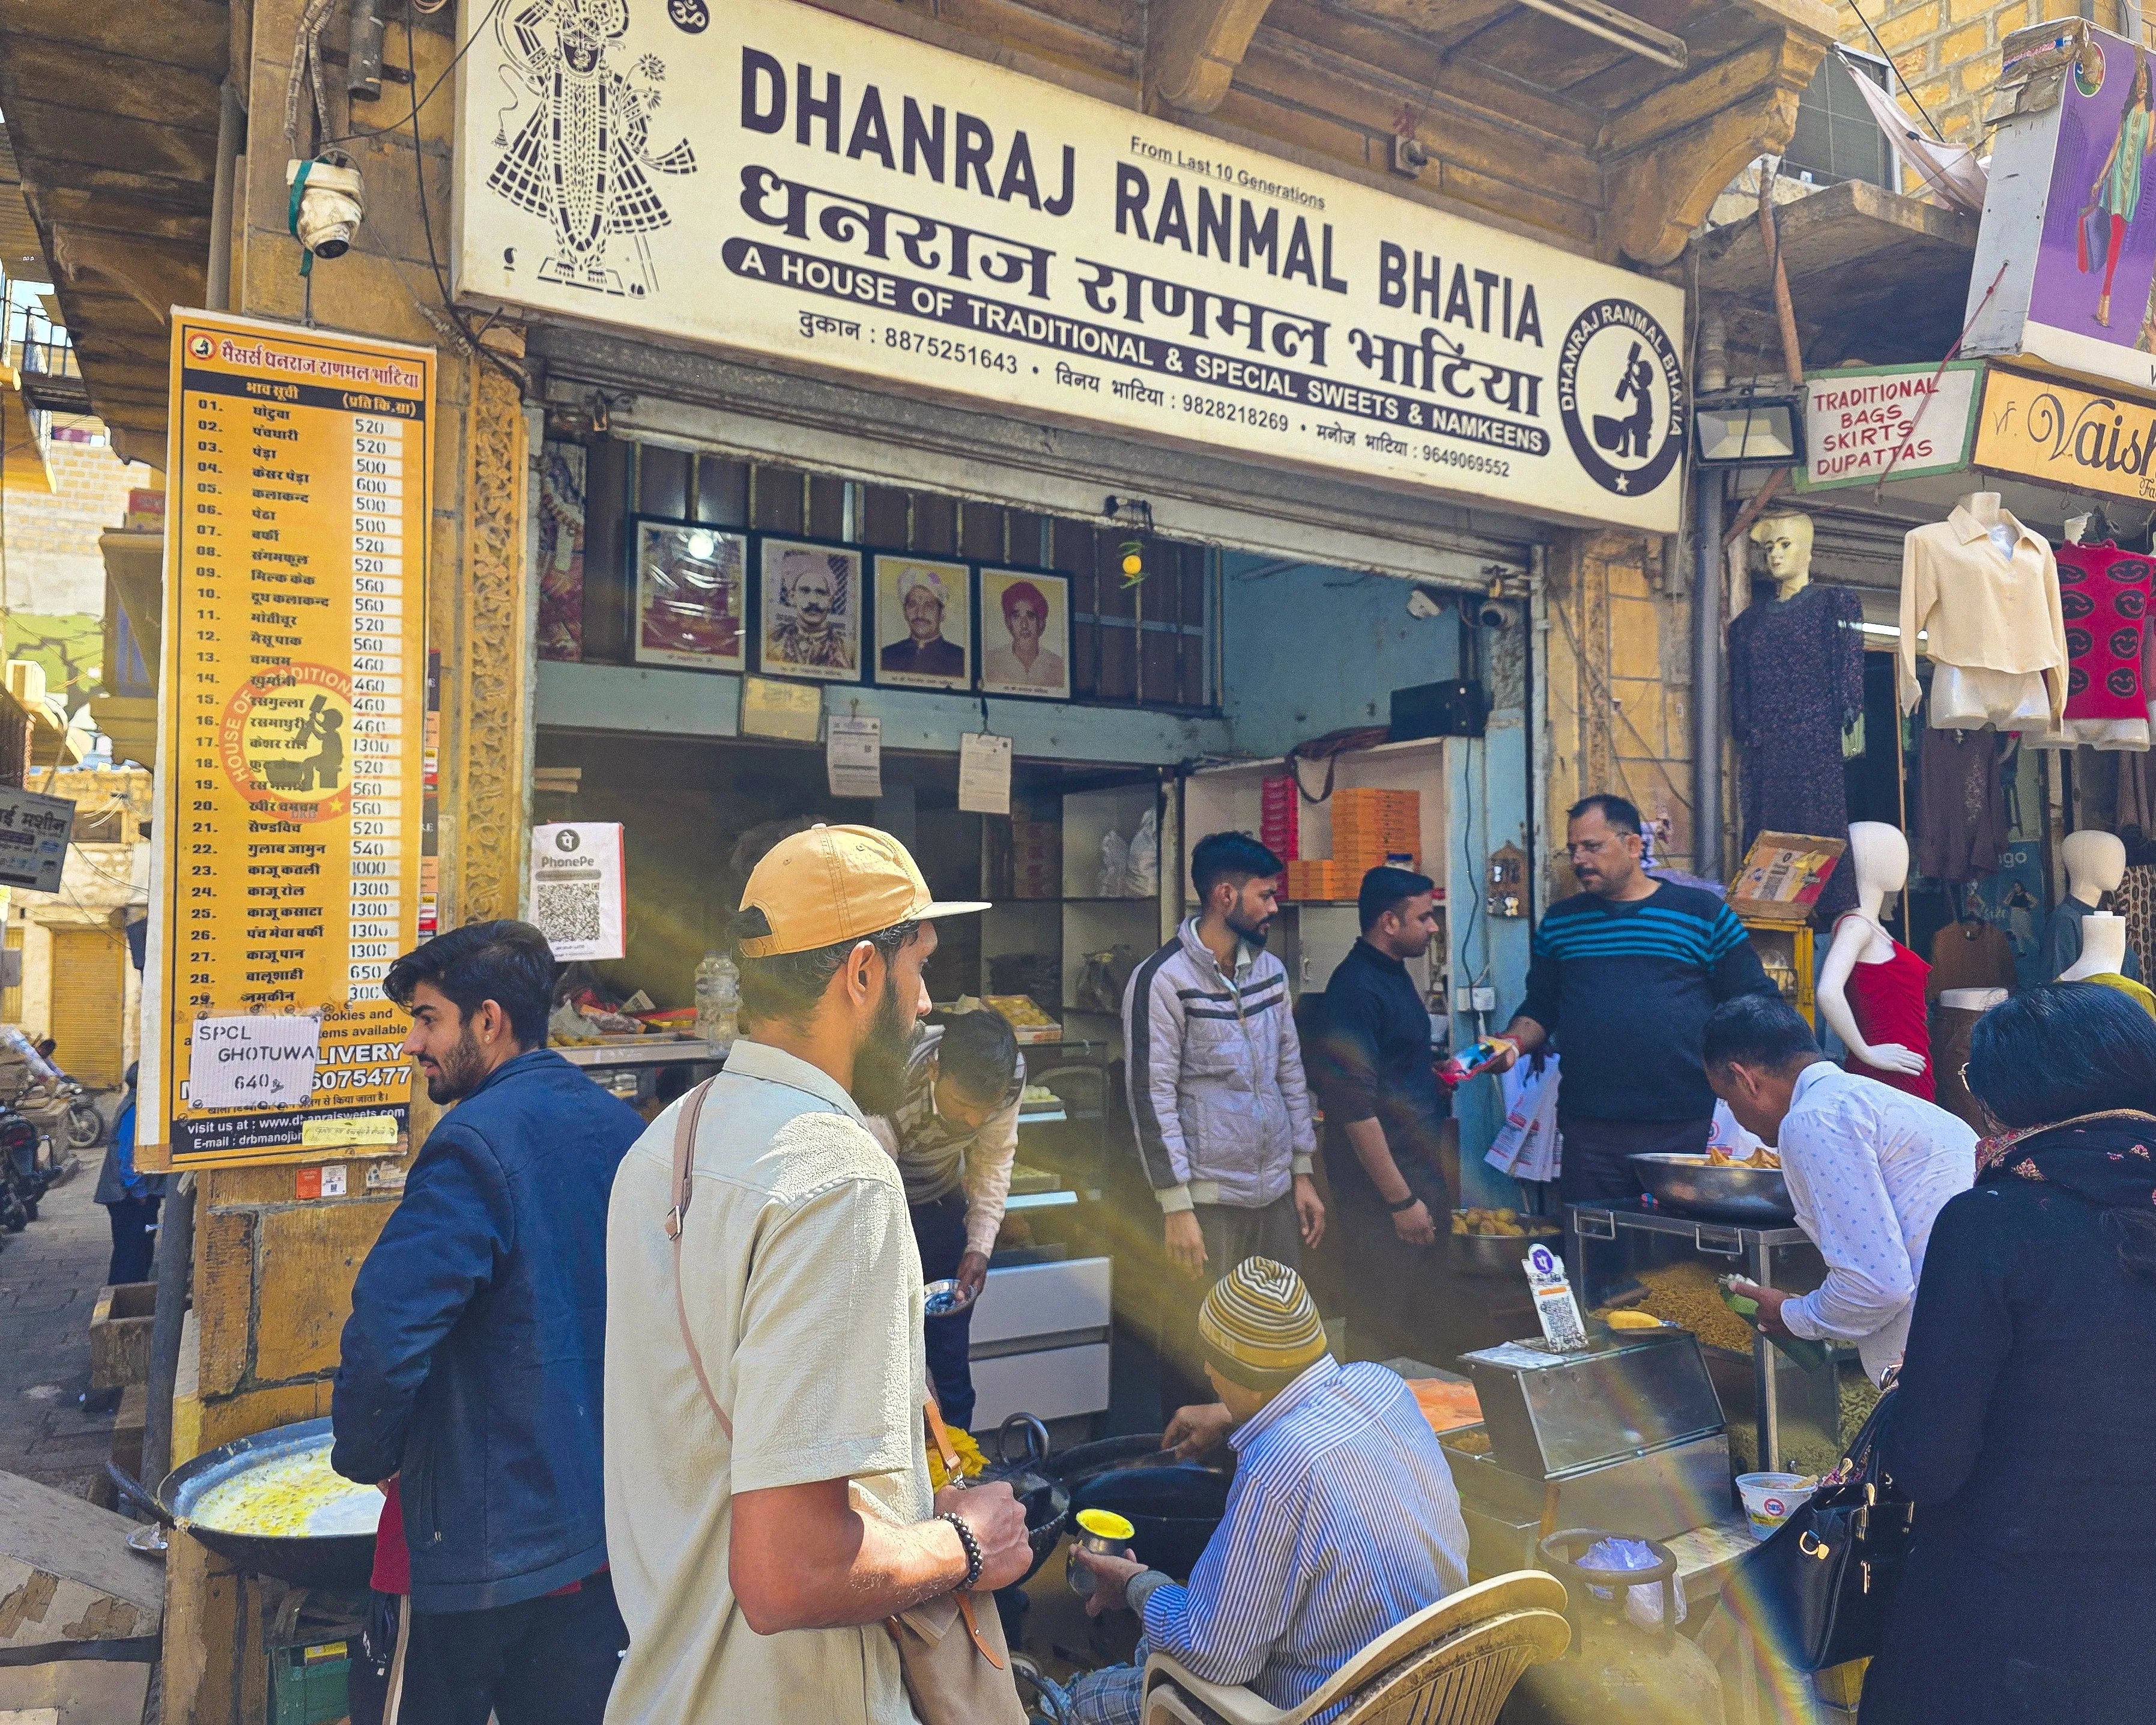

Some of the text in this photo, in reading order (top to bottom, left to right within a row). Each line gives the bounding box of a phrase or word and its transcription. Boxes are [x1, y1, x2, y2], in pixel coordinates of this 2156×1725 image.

[1131, 136, 1326, 208] From Last 10 Generations
[741, 46, 1544, 347] DHANRAJ RANMAL BHATIA
[740, 164, 1545, 417] धनराज राणमल भाटिया
[740, 247, 1542, 452] A HOUSE OF TRADITIONAL & SPECIAL SWEETS & NAMKEENS
[222, 341, 419, 388] मैसर्स धनराज राणमल भाटिया
[1561, 305, 1682, 435] DHANRAJ RANMAL BHATIA
[799, 310, 1510, 477] दुकान 8875251643 विनय भाटिया 9828218269 मनोज भाटिया 9649069552
[1814, 378, 1939, 411] TRADITIONAL
[1841, 405, 1903, 429] BAGS
[356, 419, 384, 434] 520
[1823, 421, 1914, 452] SKIRTS
[357, 438, 386, 455] 520
[1817, 440, 1933, 476] DUPATTAS
[357, 458, 386, 474] 500
[357, 477, 386, 494] 600
[357, 497, 386, 512] 500
[356, 518, 385, 533] 500
[356, 538, 384, 553] 520
[355, 558, 383, 573] 520
[356, 578, 384, 593] 560
[356, 598, 384, 612] 560
[356, 617, 384, 632] 520
[354, 637, 383, 652] 560
[354, 657, 384, 671] 460
[355, 678, 384, 693] 460
[354, 697, 385, 712] 460
[353, 719, 386, 733] 460
[225, 718, 249, 782] HOUSE
[354, 739, 389, 753] 1300
[354, 760, 383, 774] 520
[353, 782, 382, 796] 560
[353, 801, 381, 815] 560
[353, 821, 383, 835] 520
[247, 844, 286, 858] गुलाब
[288, 844, 327, 858] जामुन
[353, 841, 383, 856] 540
[542, 856, 594, 868] PhonePe
[280, 883, 306, 896] रोल
[353, 882, 389, 896] 1300
[352, 903, 387, 917] 1300
[279, 949, 306, 959] पान
[352, 944, 386, 957] 1300
[350, 965, 381, 979] 650
[323, 1008, 393, 1021] ookies and
[199, 1026, 252, 1040] SPCL
[353, 1023, 407, 1037] available
[219, 1046, 314, 1062] GHOTUWA
[316, 1043, 404, 1065] LIVERY
[235, 1074, 268, 1090] 640
[312, 1066, 411, 1091] 6075477
[187, 1123, 214, 1135] visit
[217, 1122, 233, 1132] us
[237, 1121, 247, 1130] at
[194, 1138, 229, 1150] E-mail
